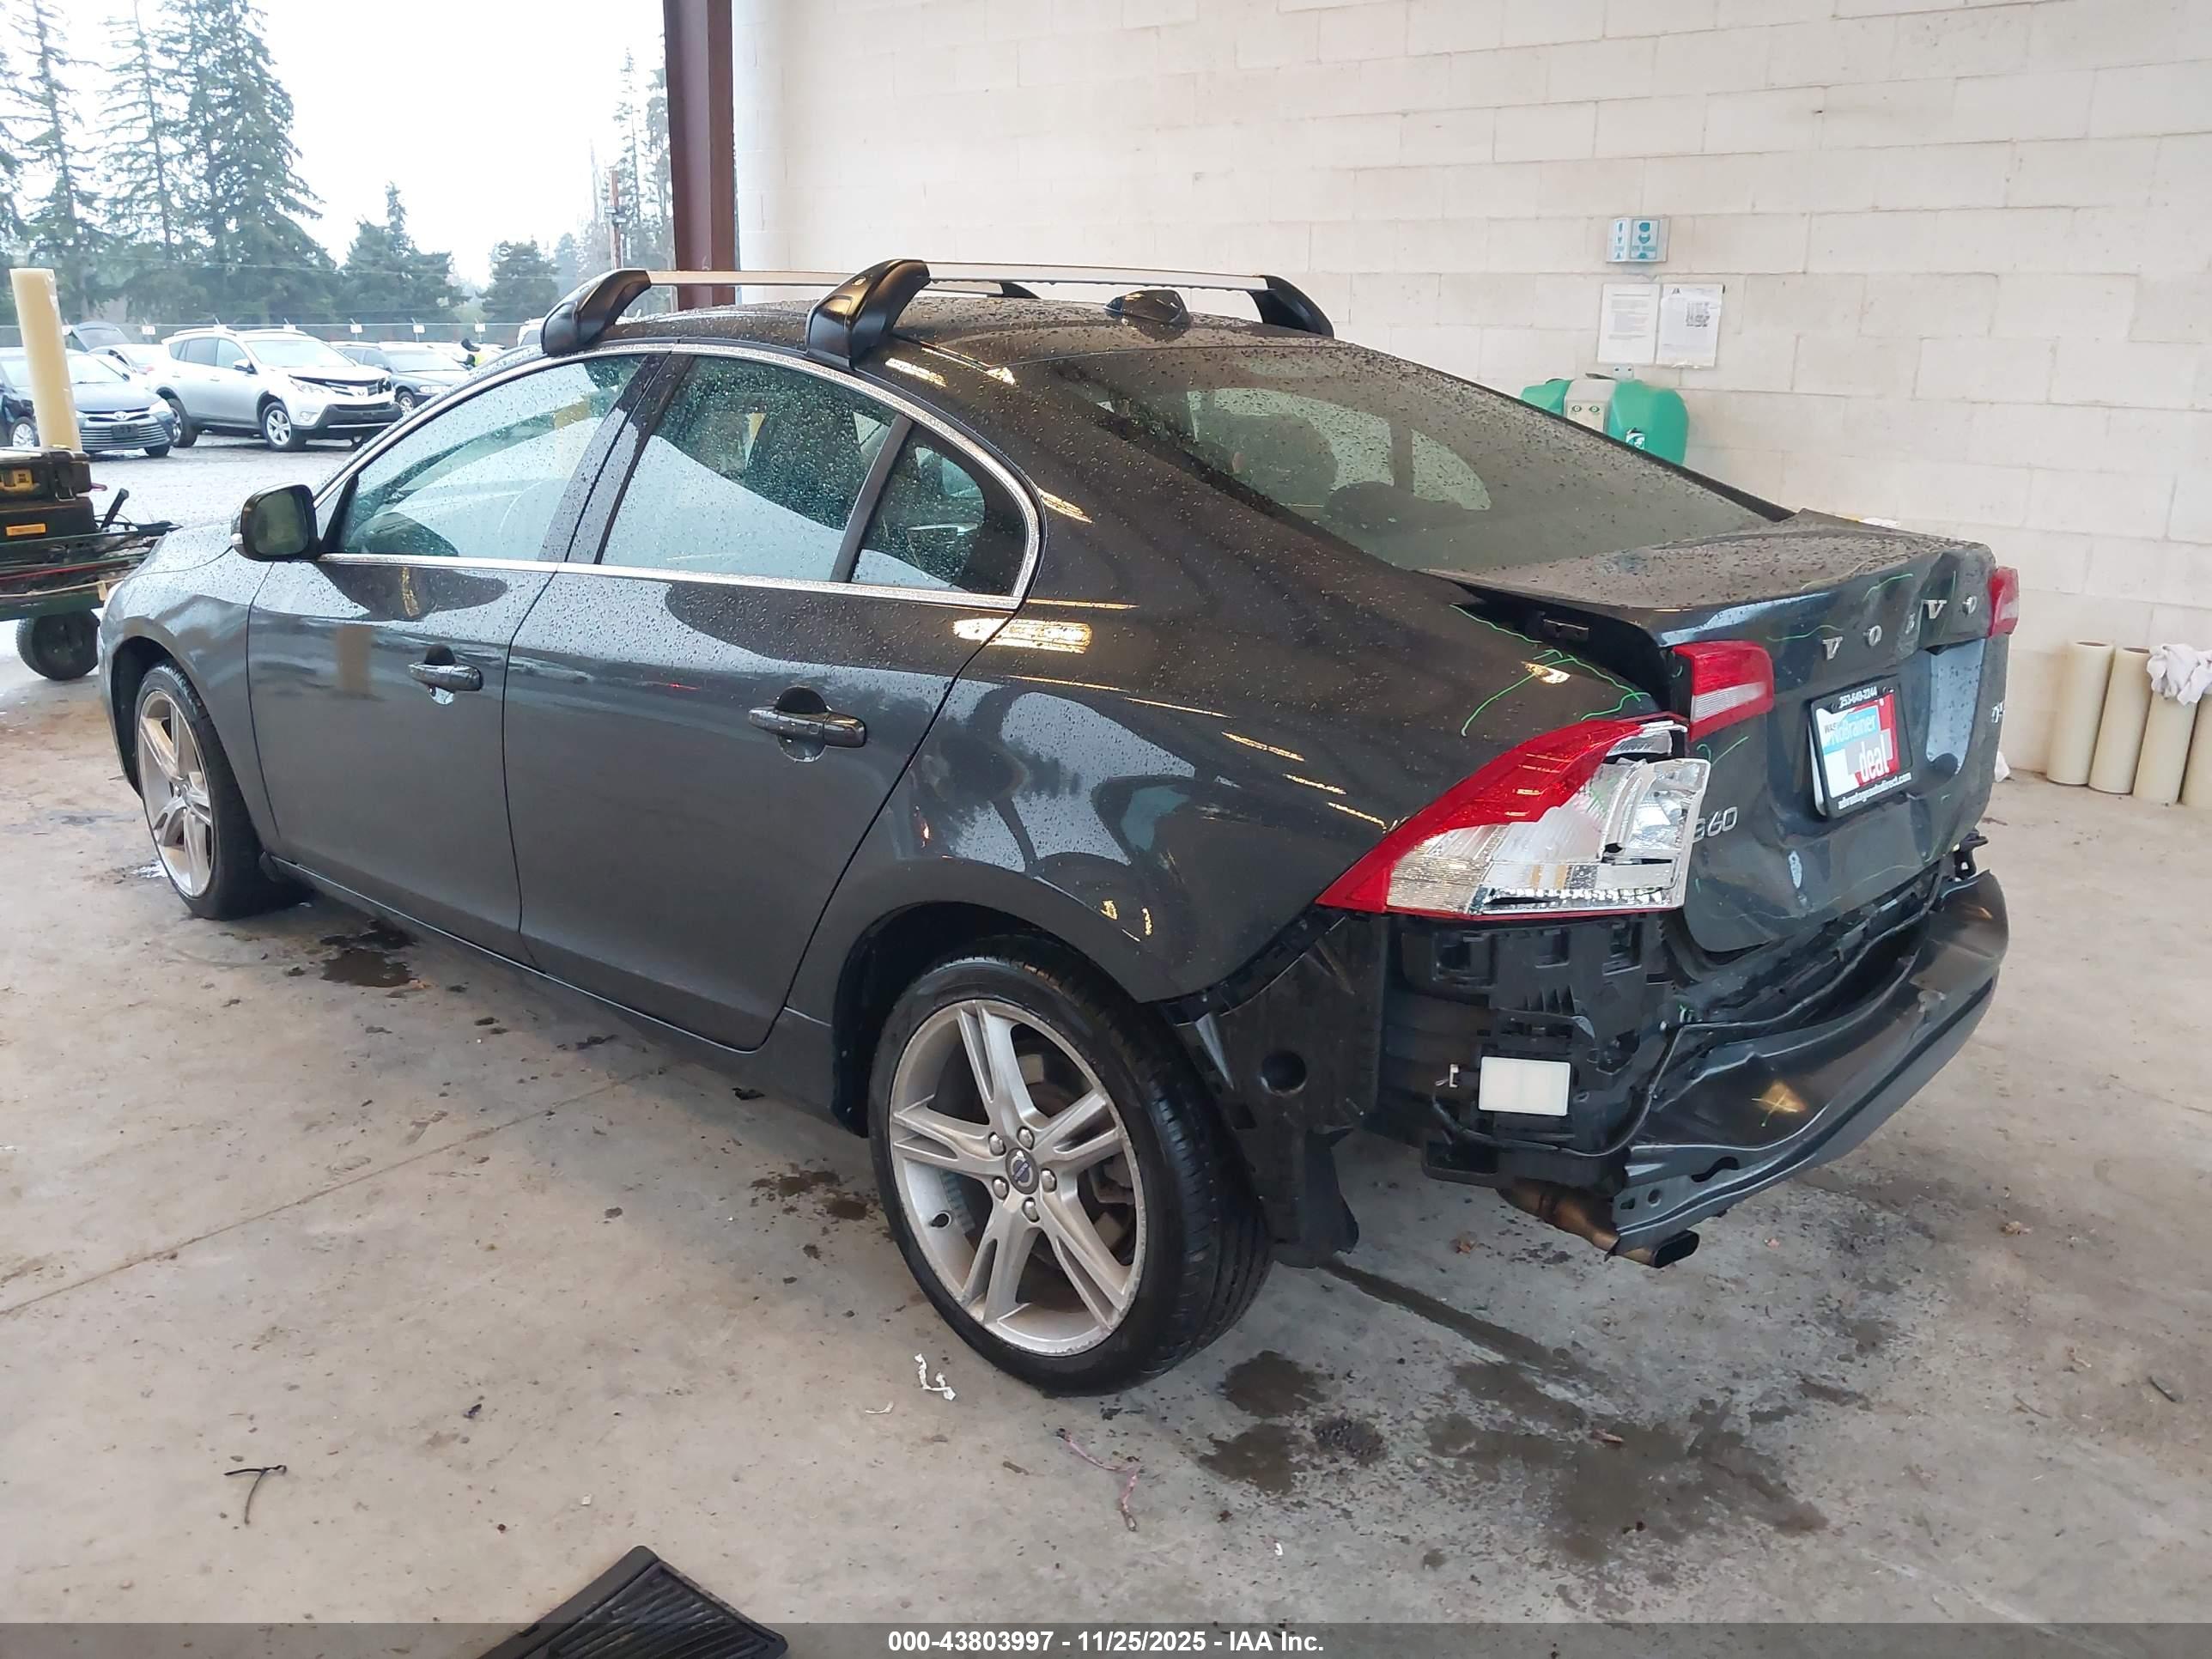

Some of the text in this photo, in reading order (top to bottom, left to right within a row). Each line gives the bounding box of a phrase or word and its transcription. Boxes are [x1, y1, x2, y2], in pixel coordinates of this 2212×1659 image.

[1822, 595, 1978, 660] VOLVO
[1860, 733, 1889, 782] deal
[1692, 805, 1738, 843] S60
